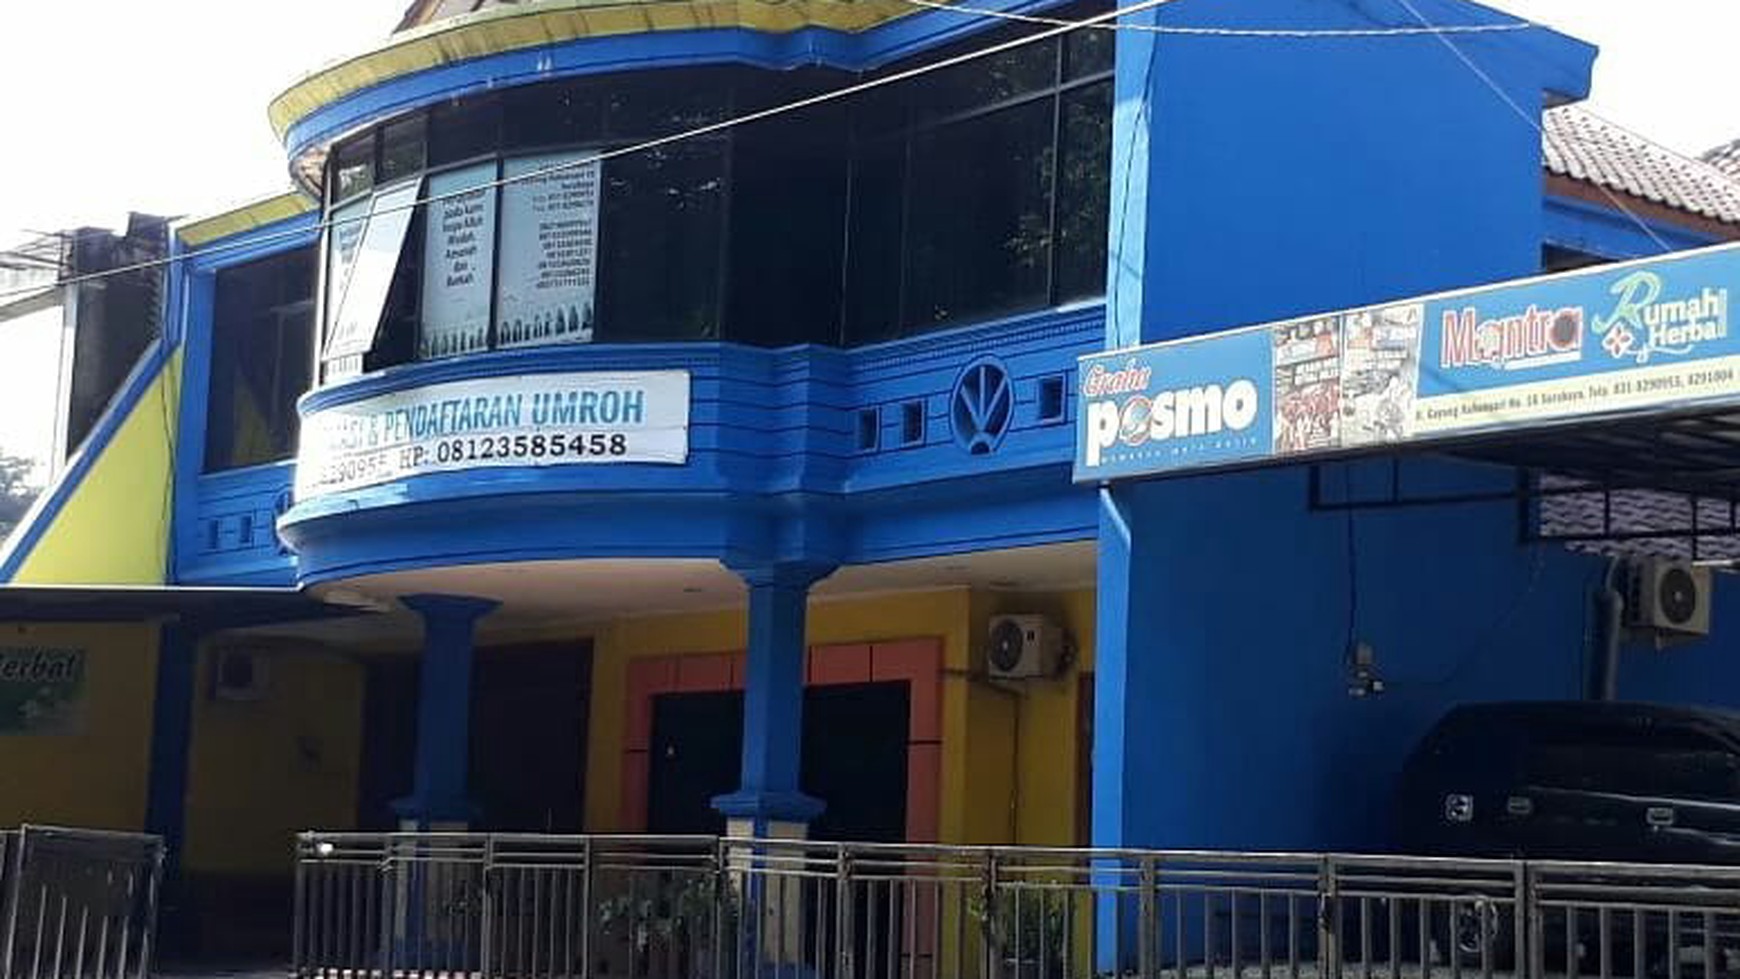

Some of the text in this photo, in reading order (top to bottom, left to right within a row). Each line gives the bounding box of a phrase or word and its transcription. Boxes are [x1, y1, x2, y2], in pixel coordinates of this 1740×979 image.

[1592, 271, 1719, 334] Rumah
[1648, 291, 1728, 347] Herbal
[1441, 304, 1583, 368] Mantra
[384, 393, 523, 442] PENDAFTARAN
[532, 390, 644, 425] UMROH
[1086, 379, 1257, 467] posmo
[400, 446, 429, 469] HP:
[437, 434, 627, 462] 08123585458
[0, 652, 76, 680] erbal
